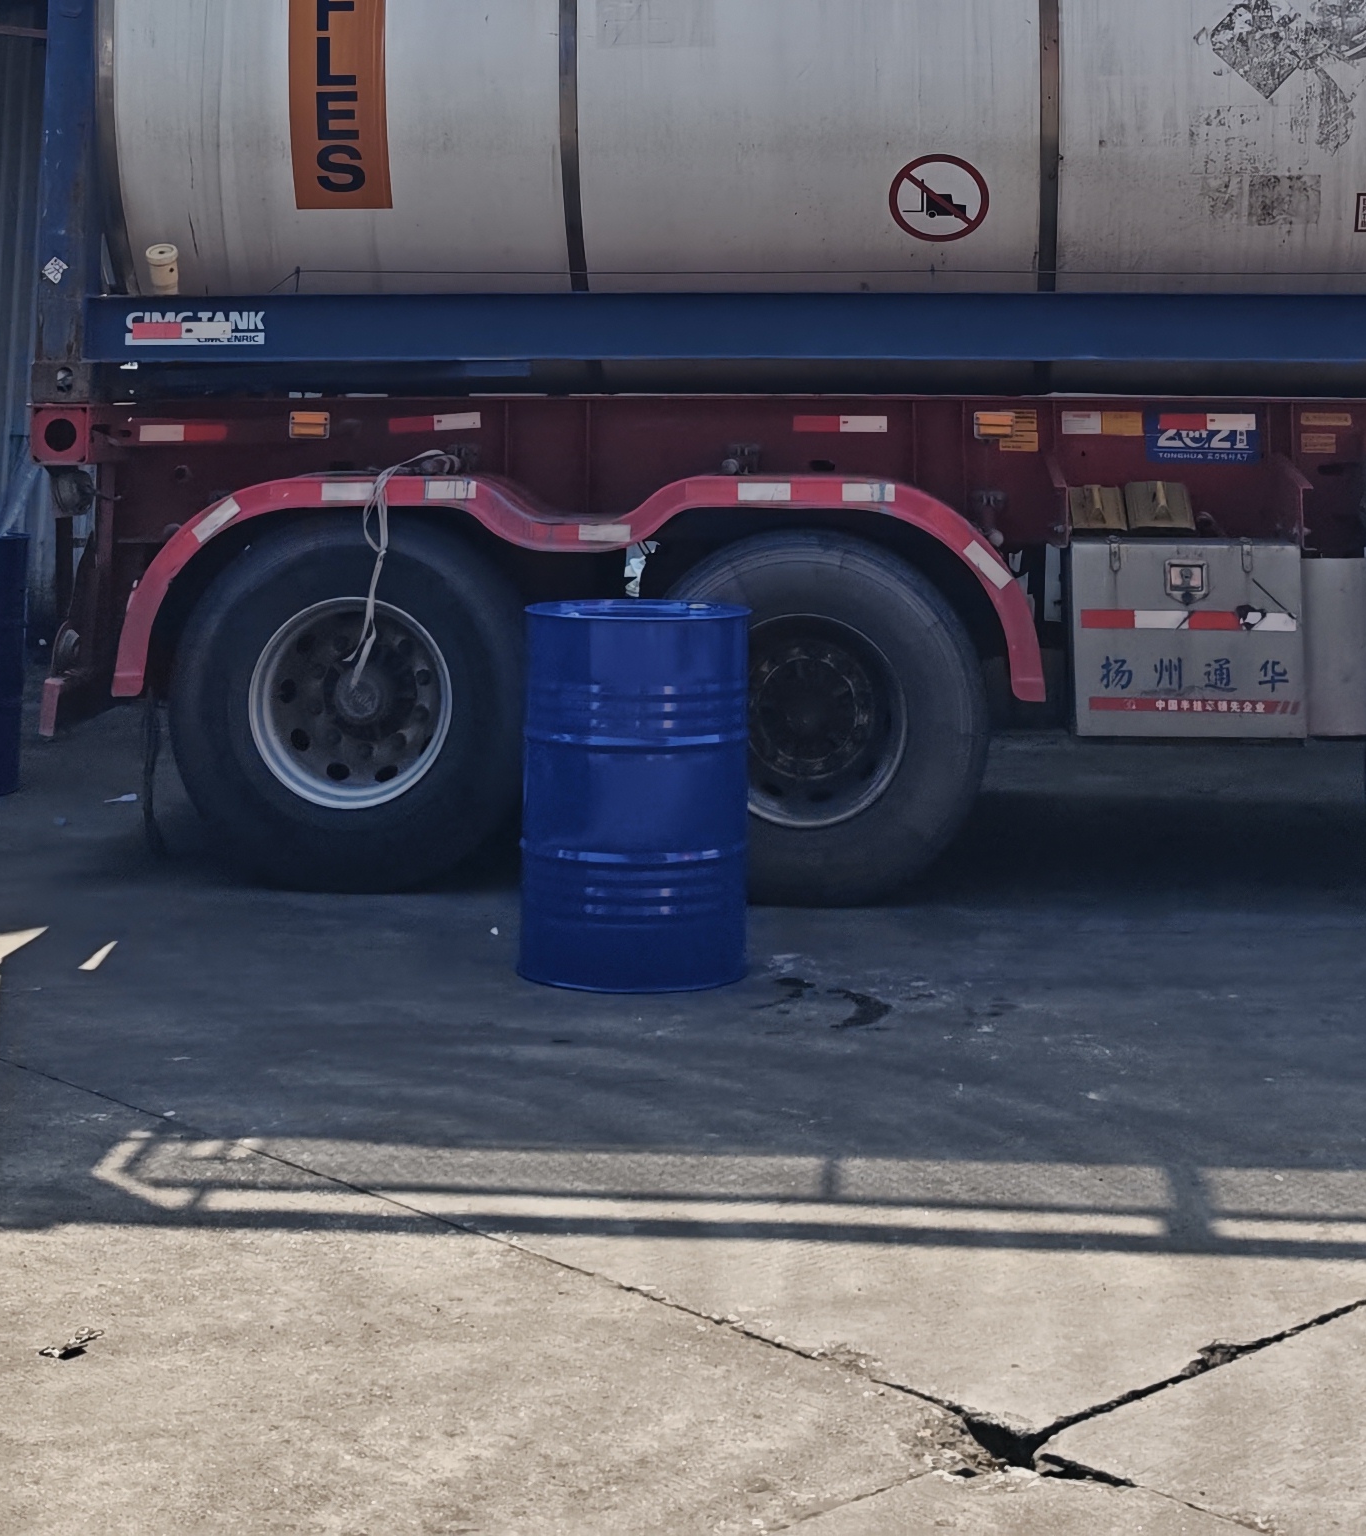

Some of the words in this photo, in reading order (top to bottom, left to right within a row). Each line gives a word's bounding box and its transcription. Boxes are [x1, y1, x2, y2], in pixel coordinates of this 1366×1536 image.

[1158, 451, 1204, 460] TONGHUA
[1100, 655, 1290, 693] 扬州通华
